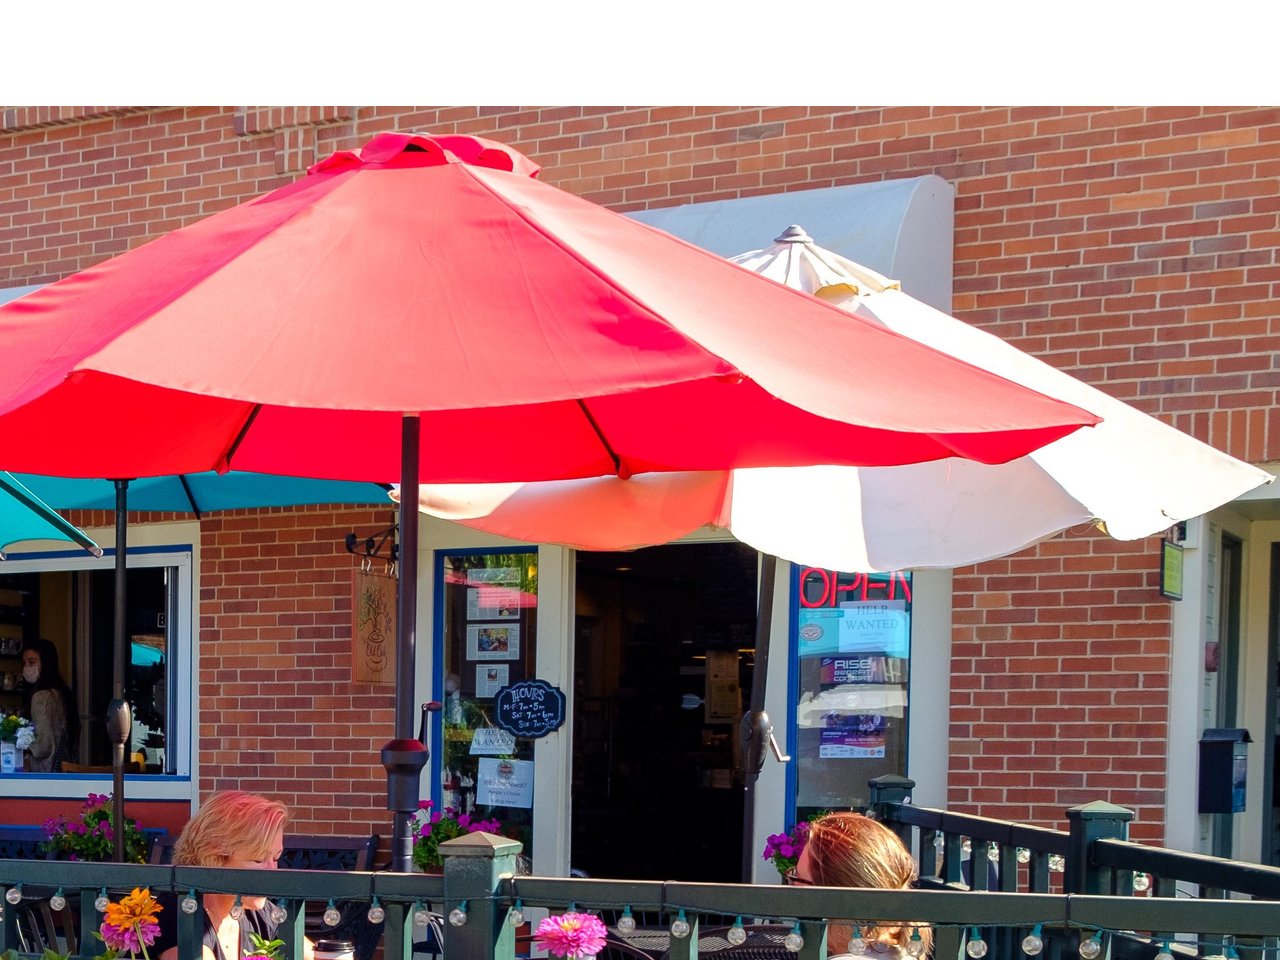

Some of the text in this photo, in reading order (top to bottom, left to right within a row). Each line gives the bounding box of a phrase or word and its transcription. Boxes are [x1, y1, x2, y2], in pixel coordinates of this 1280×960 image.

[800, 567, 911, 608] OPEN
[857, 604, 888, 616] HELP
[846, 619, 899, 631] WANTED
[834, 659, 872, 669] RISE
[511, 687, 546, 703] HOURS
